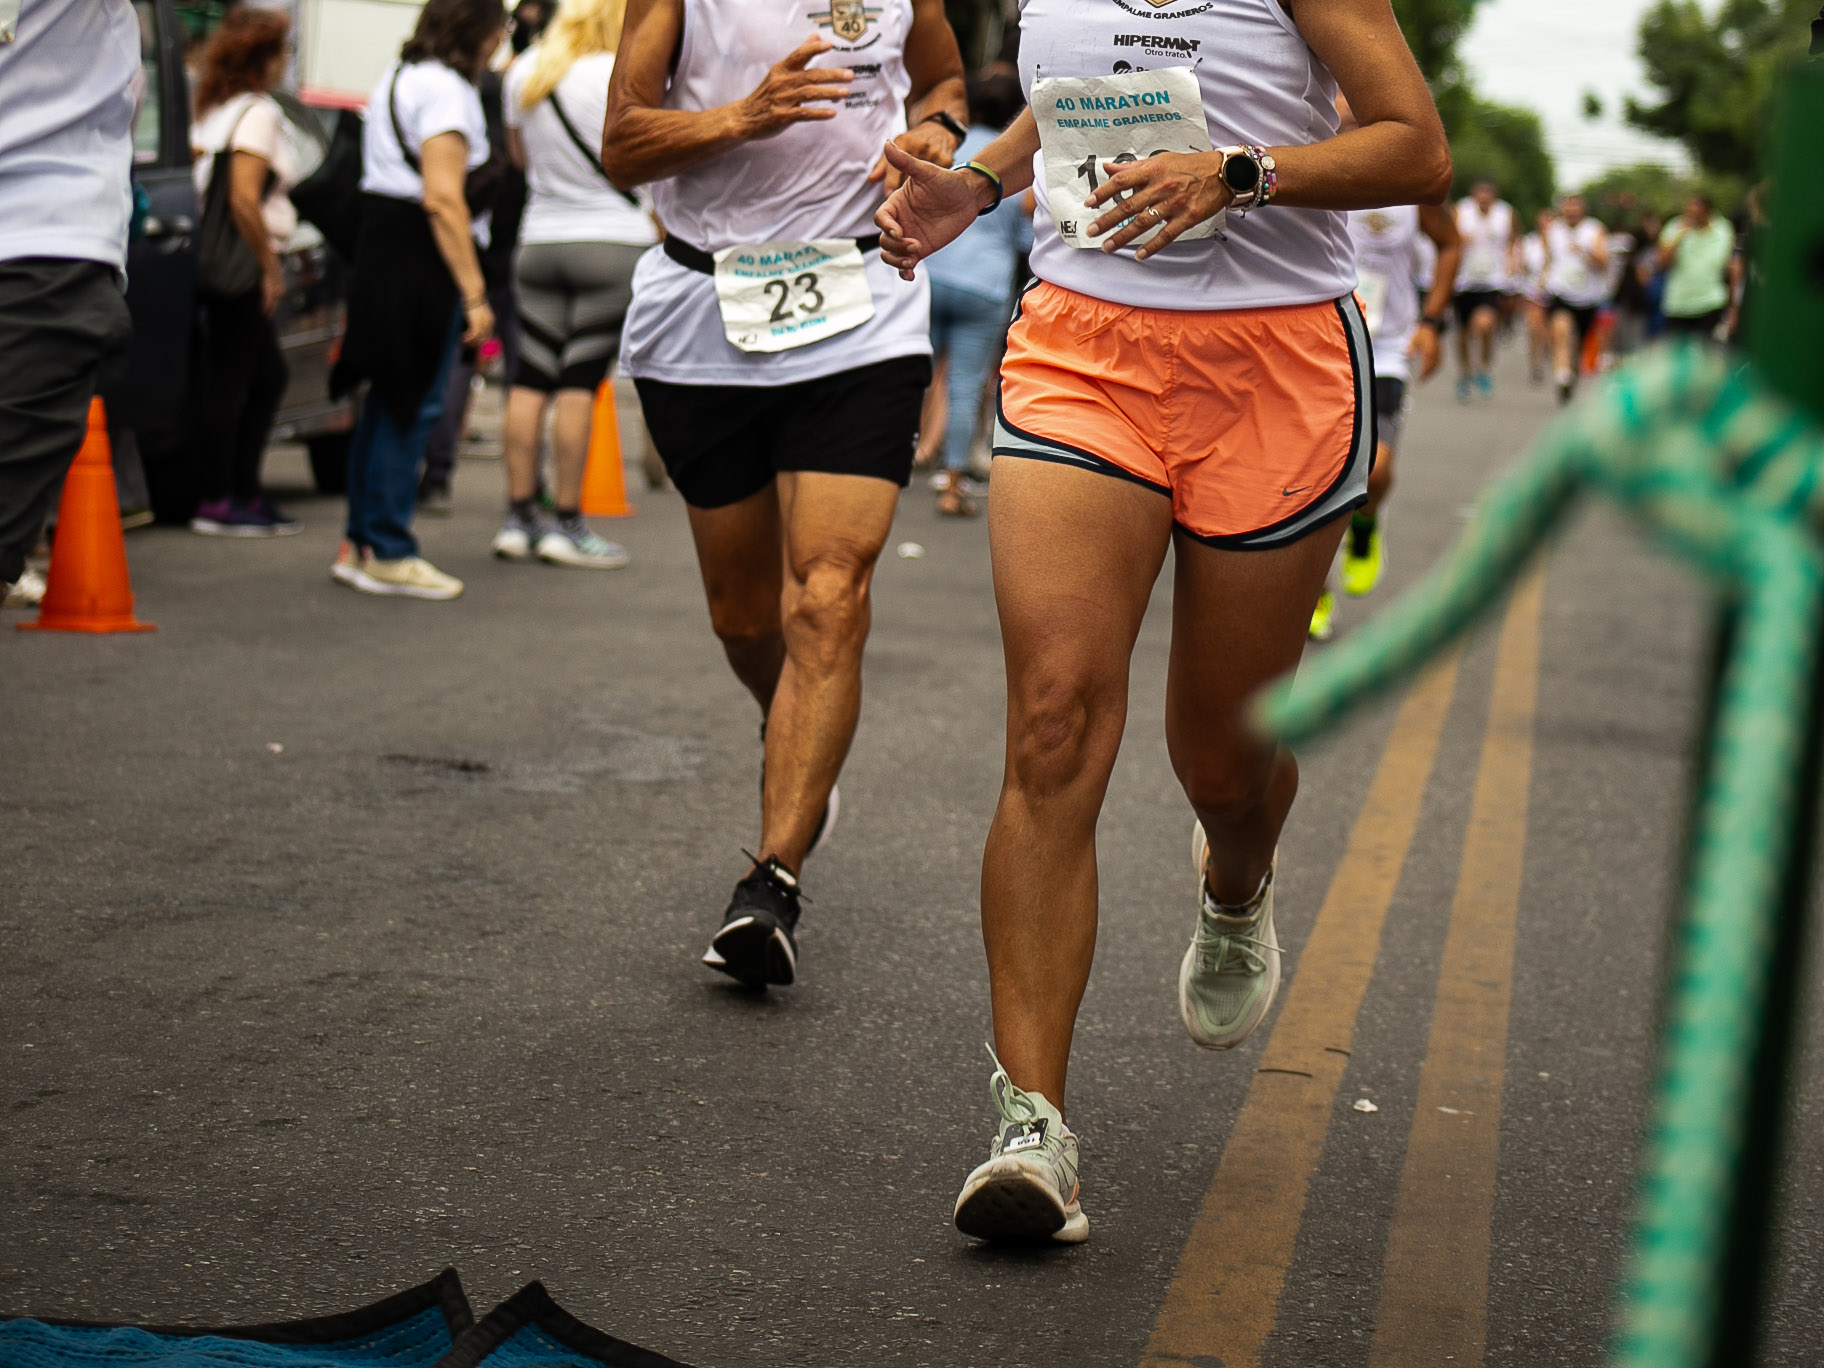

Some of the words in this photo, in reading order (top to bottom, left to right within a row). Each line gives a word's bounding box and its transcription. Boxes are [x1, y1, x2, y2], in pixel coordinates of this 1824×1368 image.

[1153, 2, 1214, 19] GRANEROS
[842, 21, 860, 33] 40
[1145, 48, 1164, 57] Otro
[1165, 50, 1187, 59] trato.
[1055, 97, 1076, 111] 40
[1079, 90, 1171, 111] MARATON
[1056, 118, 1110, 129] EMPALME
[1112, 111, 1182, 127] GRANEROS
[763, 272, 825, 324] 23
